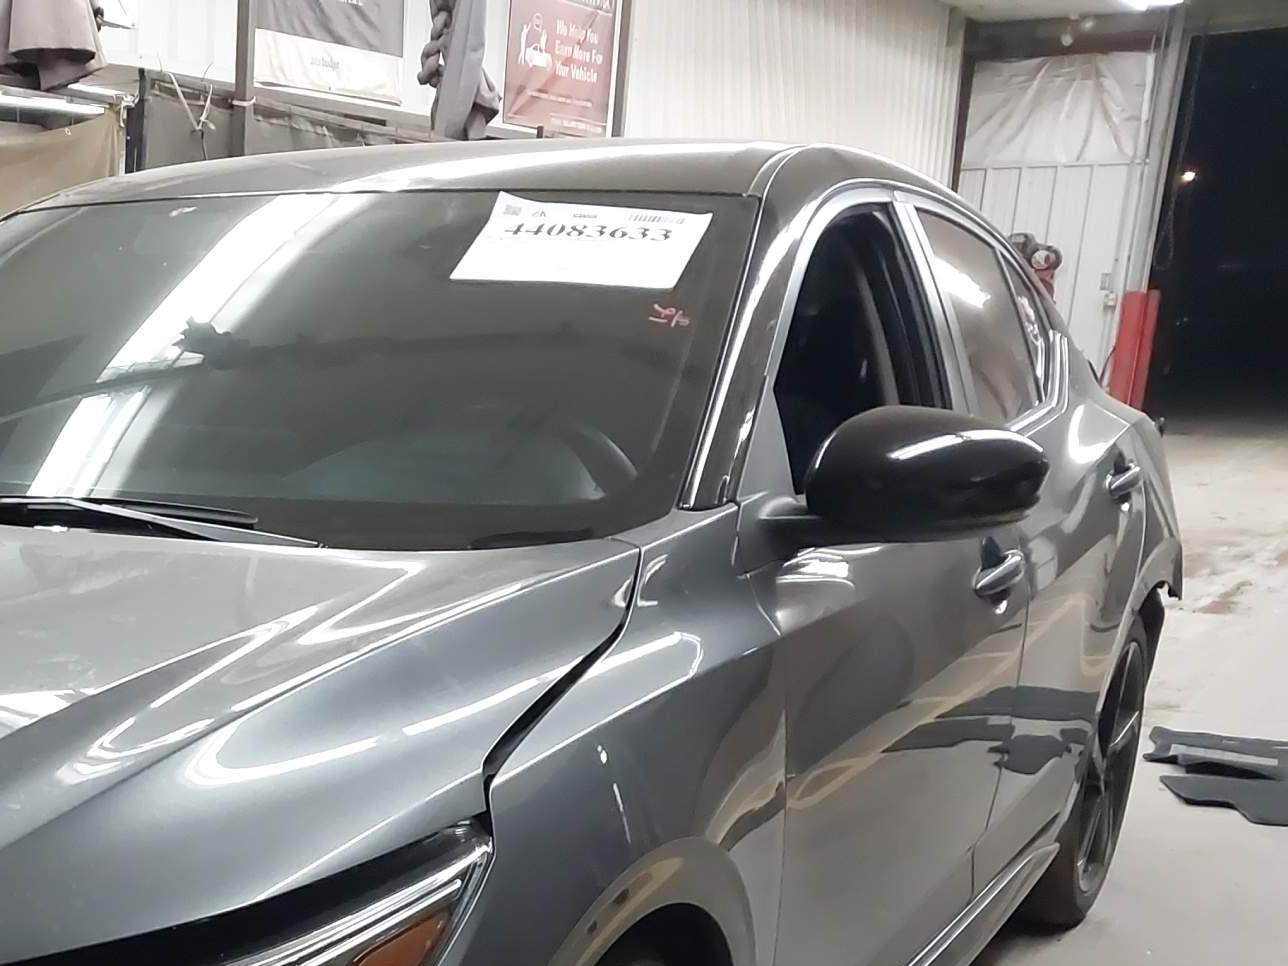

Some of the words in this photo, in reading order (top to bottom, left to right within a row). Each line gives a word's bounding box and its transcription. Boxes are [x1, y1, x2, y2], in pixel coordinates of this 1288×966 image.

[556, 19, 568, 36] We
[569, 23, 586, 43] Help
[586, 28, 599, 45] You
[555, 40, 572, 57] Earn
[573, 45, 590, 63] More
[555, 60, 569, 77] Your
[570, 64, 598, 83] Vehicle
[505, 223, 673, 241] 44083633
